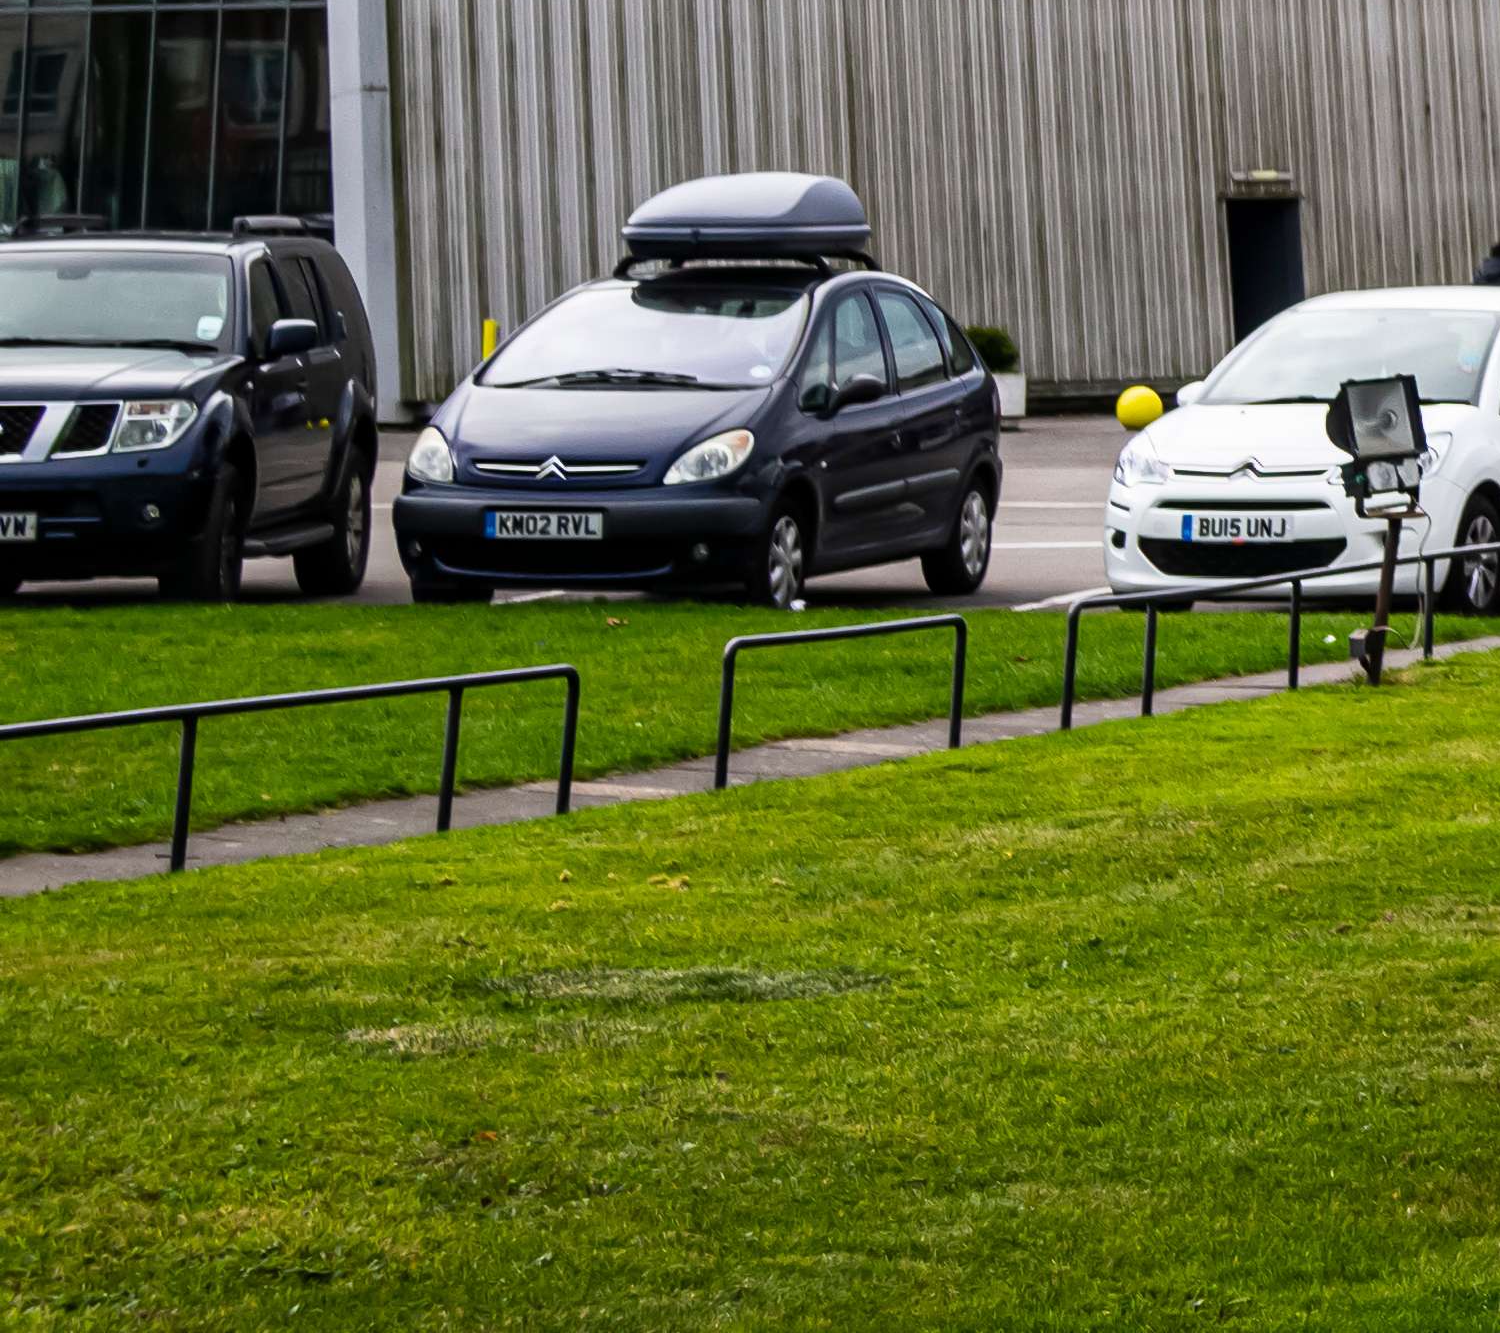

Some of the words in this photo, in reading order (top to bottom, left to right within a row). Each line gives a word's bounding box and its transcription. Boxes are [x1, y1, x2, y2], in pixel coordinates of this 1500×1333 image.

[499, 515, 552, 535] KM02
[557, 514, 597, 535] RVL
[1199, 518, 1241, 537] BU15
[1246, 517, 1286, 538] UNJ
